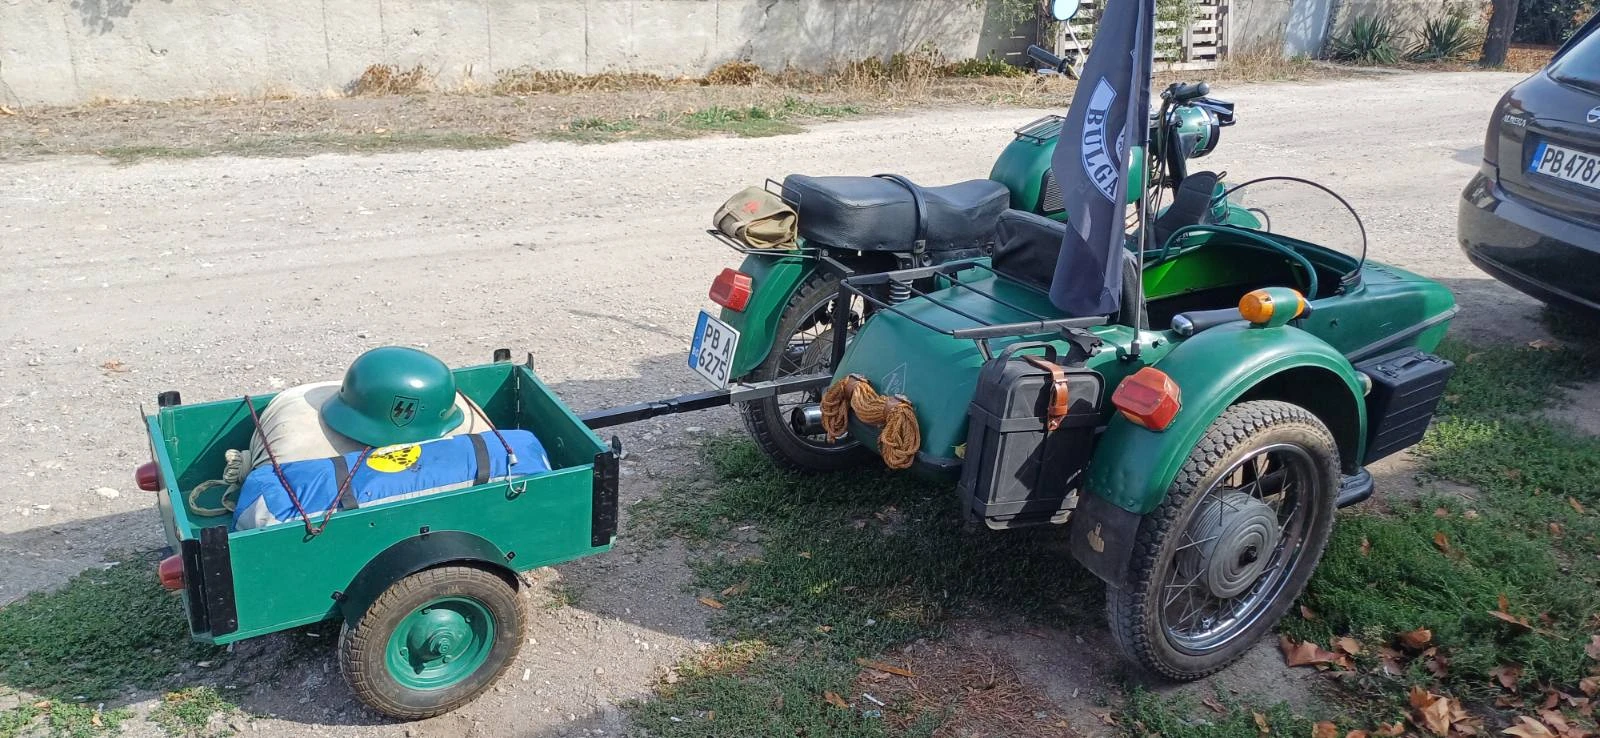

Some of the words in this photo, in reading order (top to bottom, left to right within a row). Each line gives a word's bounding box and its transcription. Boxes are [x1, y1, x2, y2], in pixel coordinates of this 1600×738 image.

[1540, 148, 1564, 173] PB
[704, 325, 720, 349] PB
[722, 338, 731, 360] A
[699, 348, 727, 380] 6275
